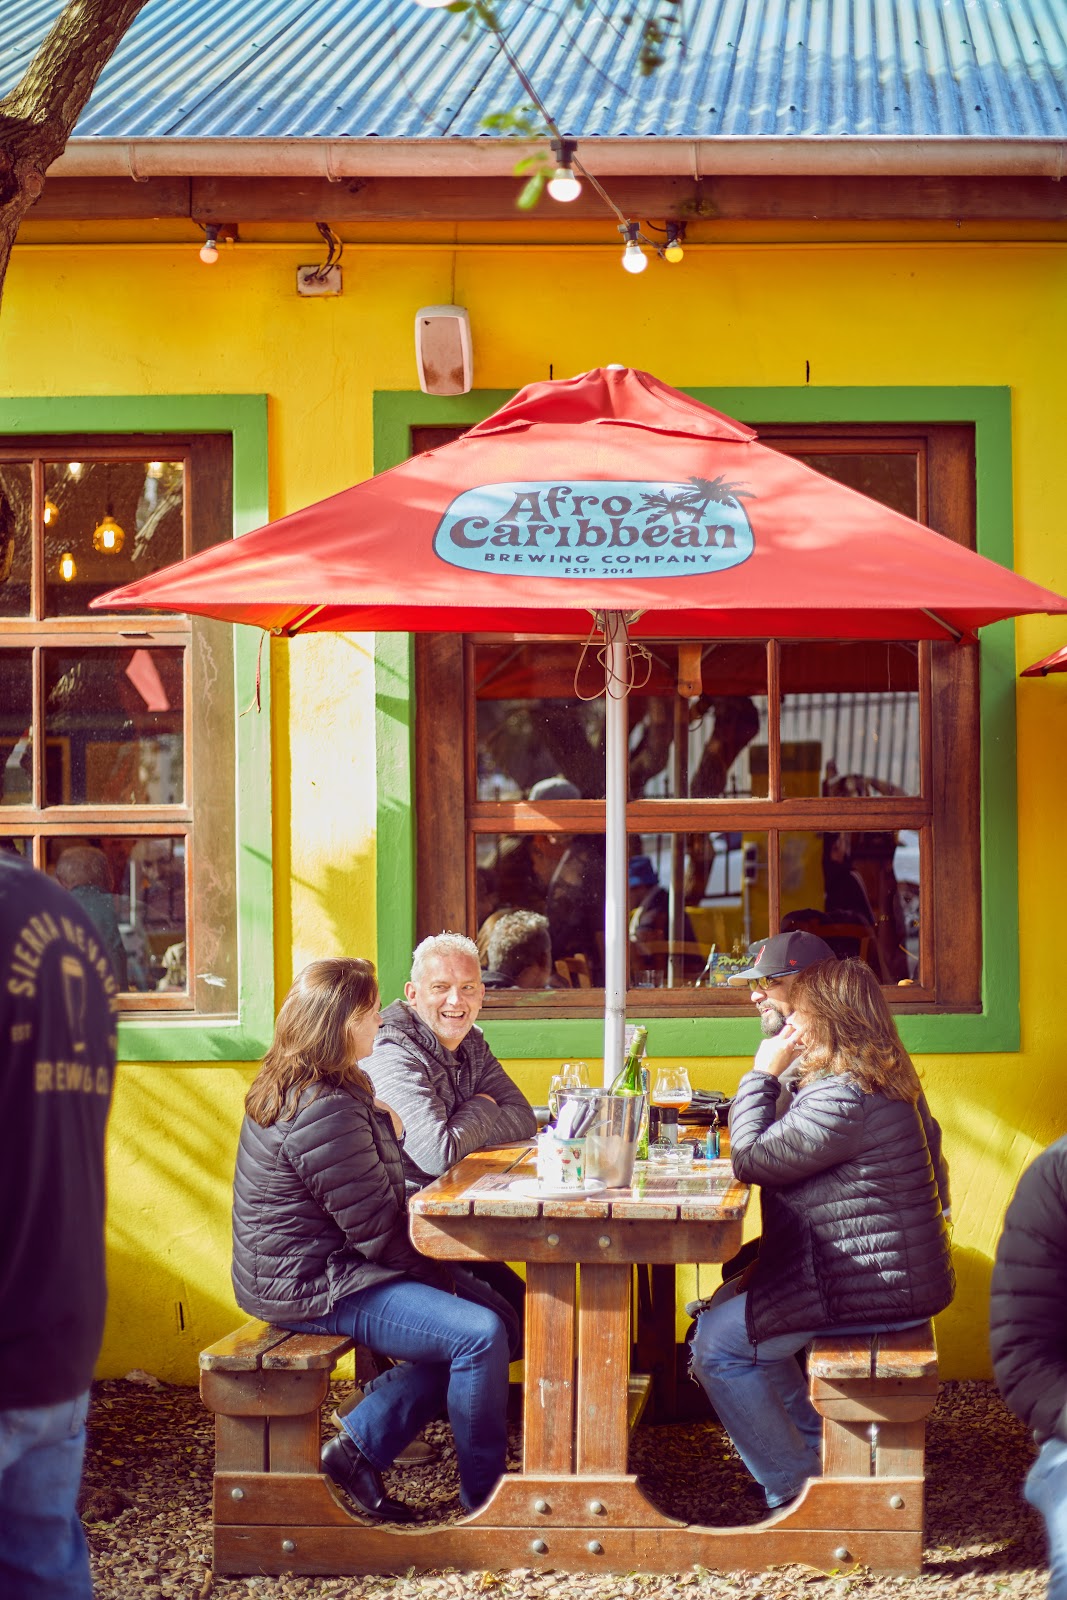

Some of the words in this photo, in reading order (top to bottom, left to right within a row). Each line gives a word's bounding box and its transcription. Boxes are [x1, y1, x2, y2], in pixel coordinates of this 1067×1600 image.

[497, 486, 633, 524] Afro
[449, 515, 737, 549] Caribbean
[484, 553, 590, 564] BREWING
[601, 553, 713, 564] COMPANY
